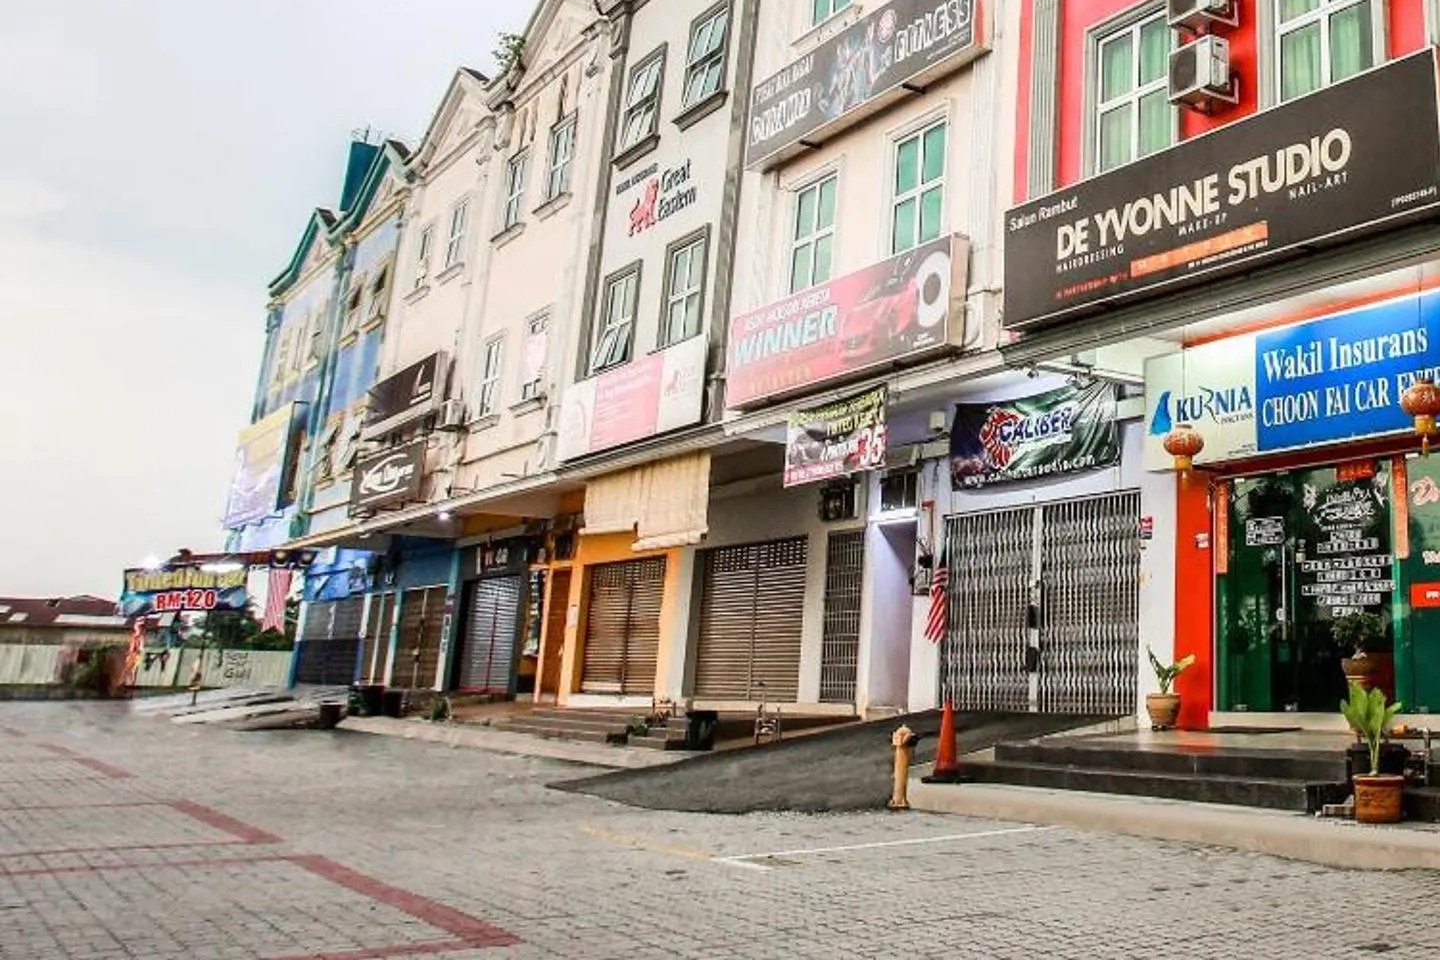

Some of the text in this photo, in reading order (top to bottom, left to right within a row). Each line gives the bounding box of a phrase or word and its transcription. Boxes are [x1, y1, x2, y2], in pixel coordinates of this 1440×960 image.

[661, 158, 691, 193] Great
[1057, 217, 1090, 260] DE
[1094, 174, 1220, 246] YVONNE
[1228, 128, 1352, 204] STUDIO
[734, 304, 839, 366] WINNER
[1263, 327, 1428, 384] Wakil Insurans
[999, 407, 1072, 442] CALIBER
[1176, 385, 1252, 424] KURNIA
[1262, 390, 1319, 428] CHOON
[1355, 376, 1391, 412] CAR
